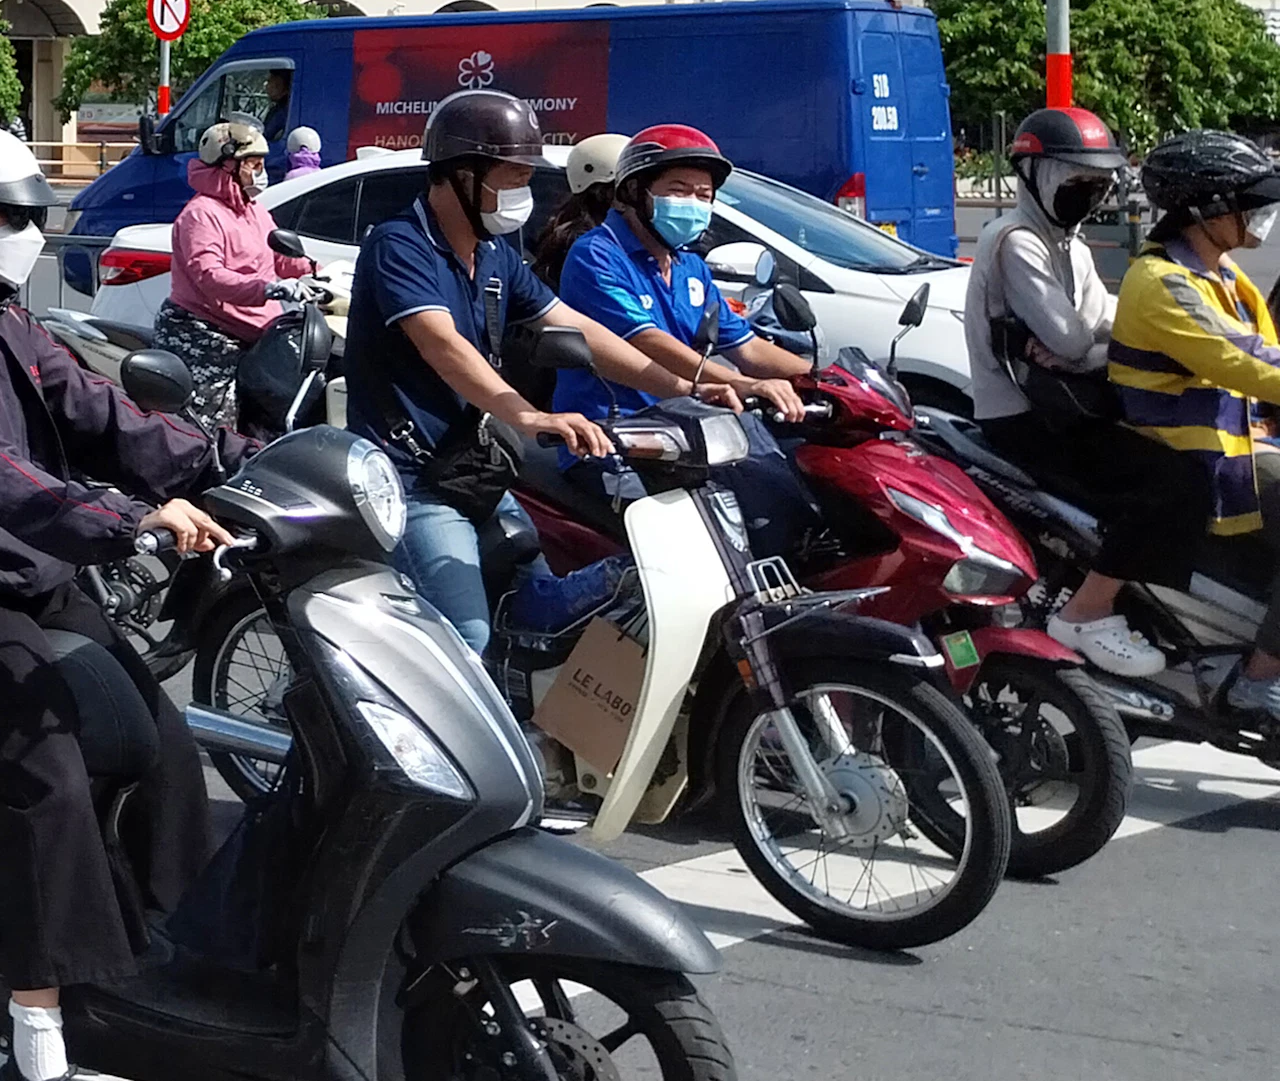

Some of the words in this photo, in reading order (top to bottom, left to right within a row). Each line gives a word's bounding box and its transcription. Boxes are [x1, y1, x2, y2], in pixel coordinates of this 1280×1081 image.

[872, 73, 889, 98] 51B
[542, 132, 577, 145] CITY
[572, 668, 594, 689] LE
[593, 683, 632, 717] LABO
